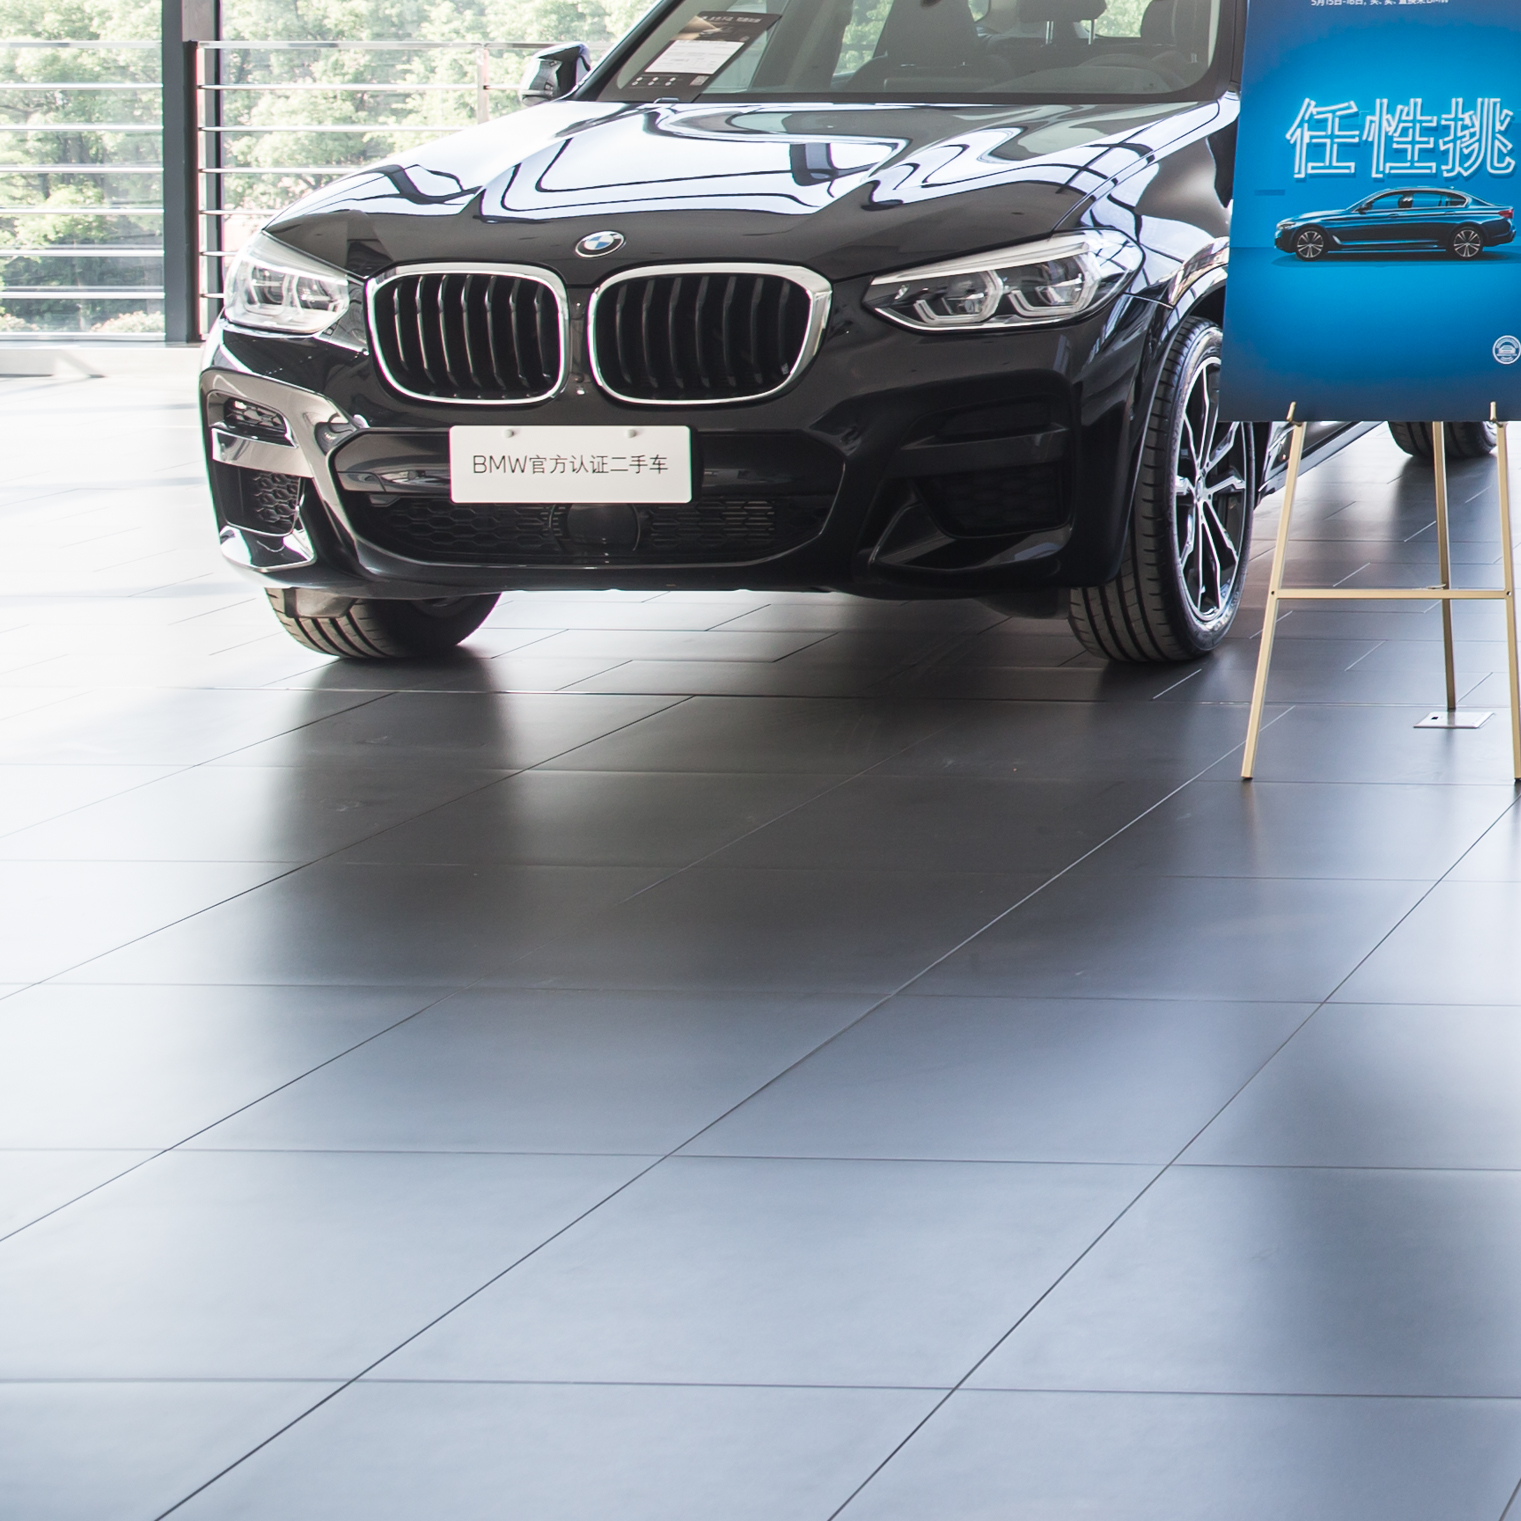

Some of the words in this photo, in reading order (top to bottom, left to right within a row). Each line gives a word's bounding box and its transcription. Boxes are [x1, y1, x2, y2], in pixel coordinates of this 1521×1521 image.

[1285, 98, 1516, 179] 任性挑
[473, 454, 669, 475] BMW官方认证二手车
